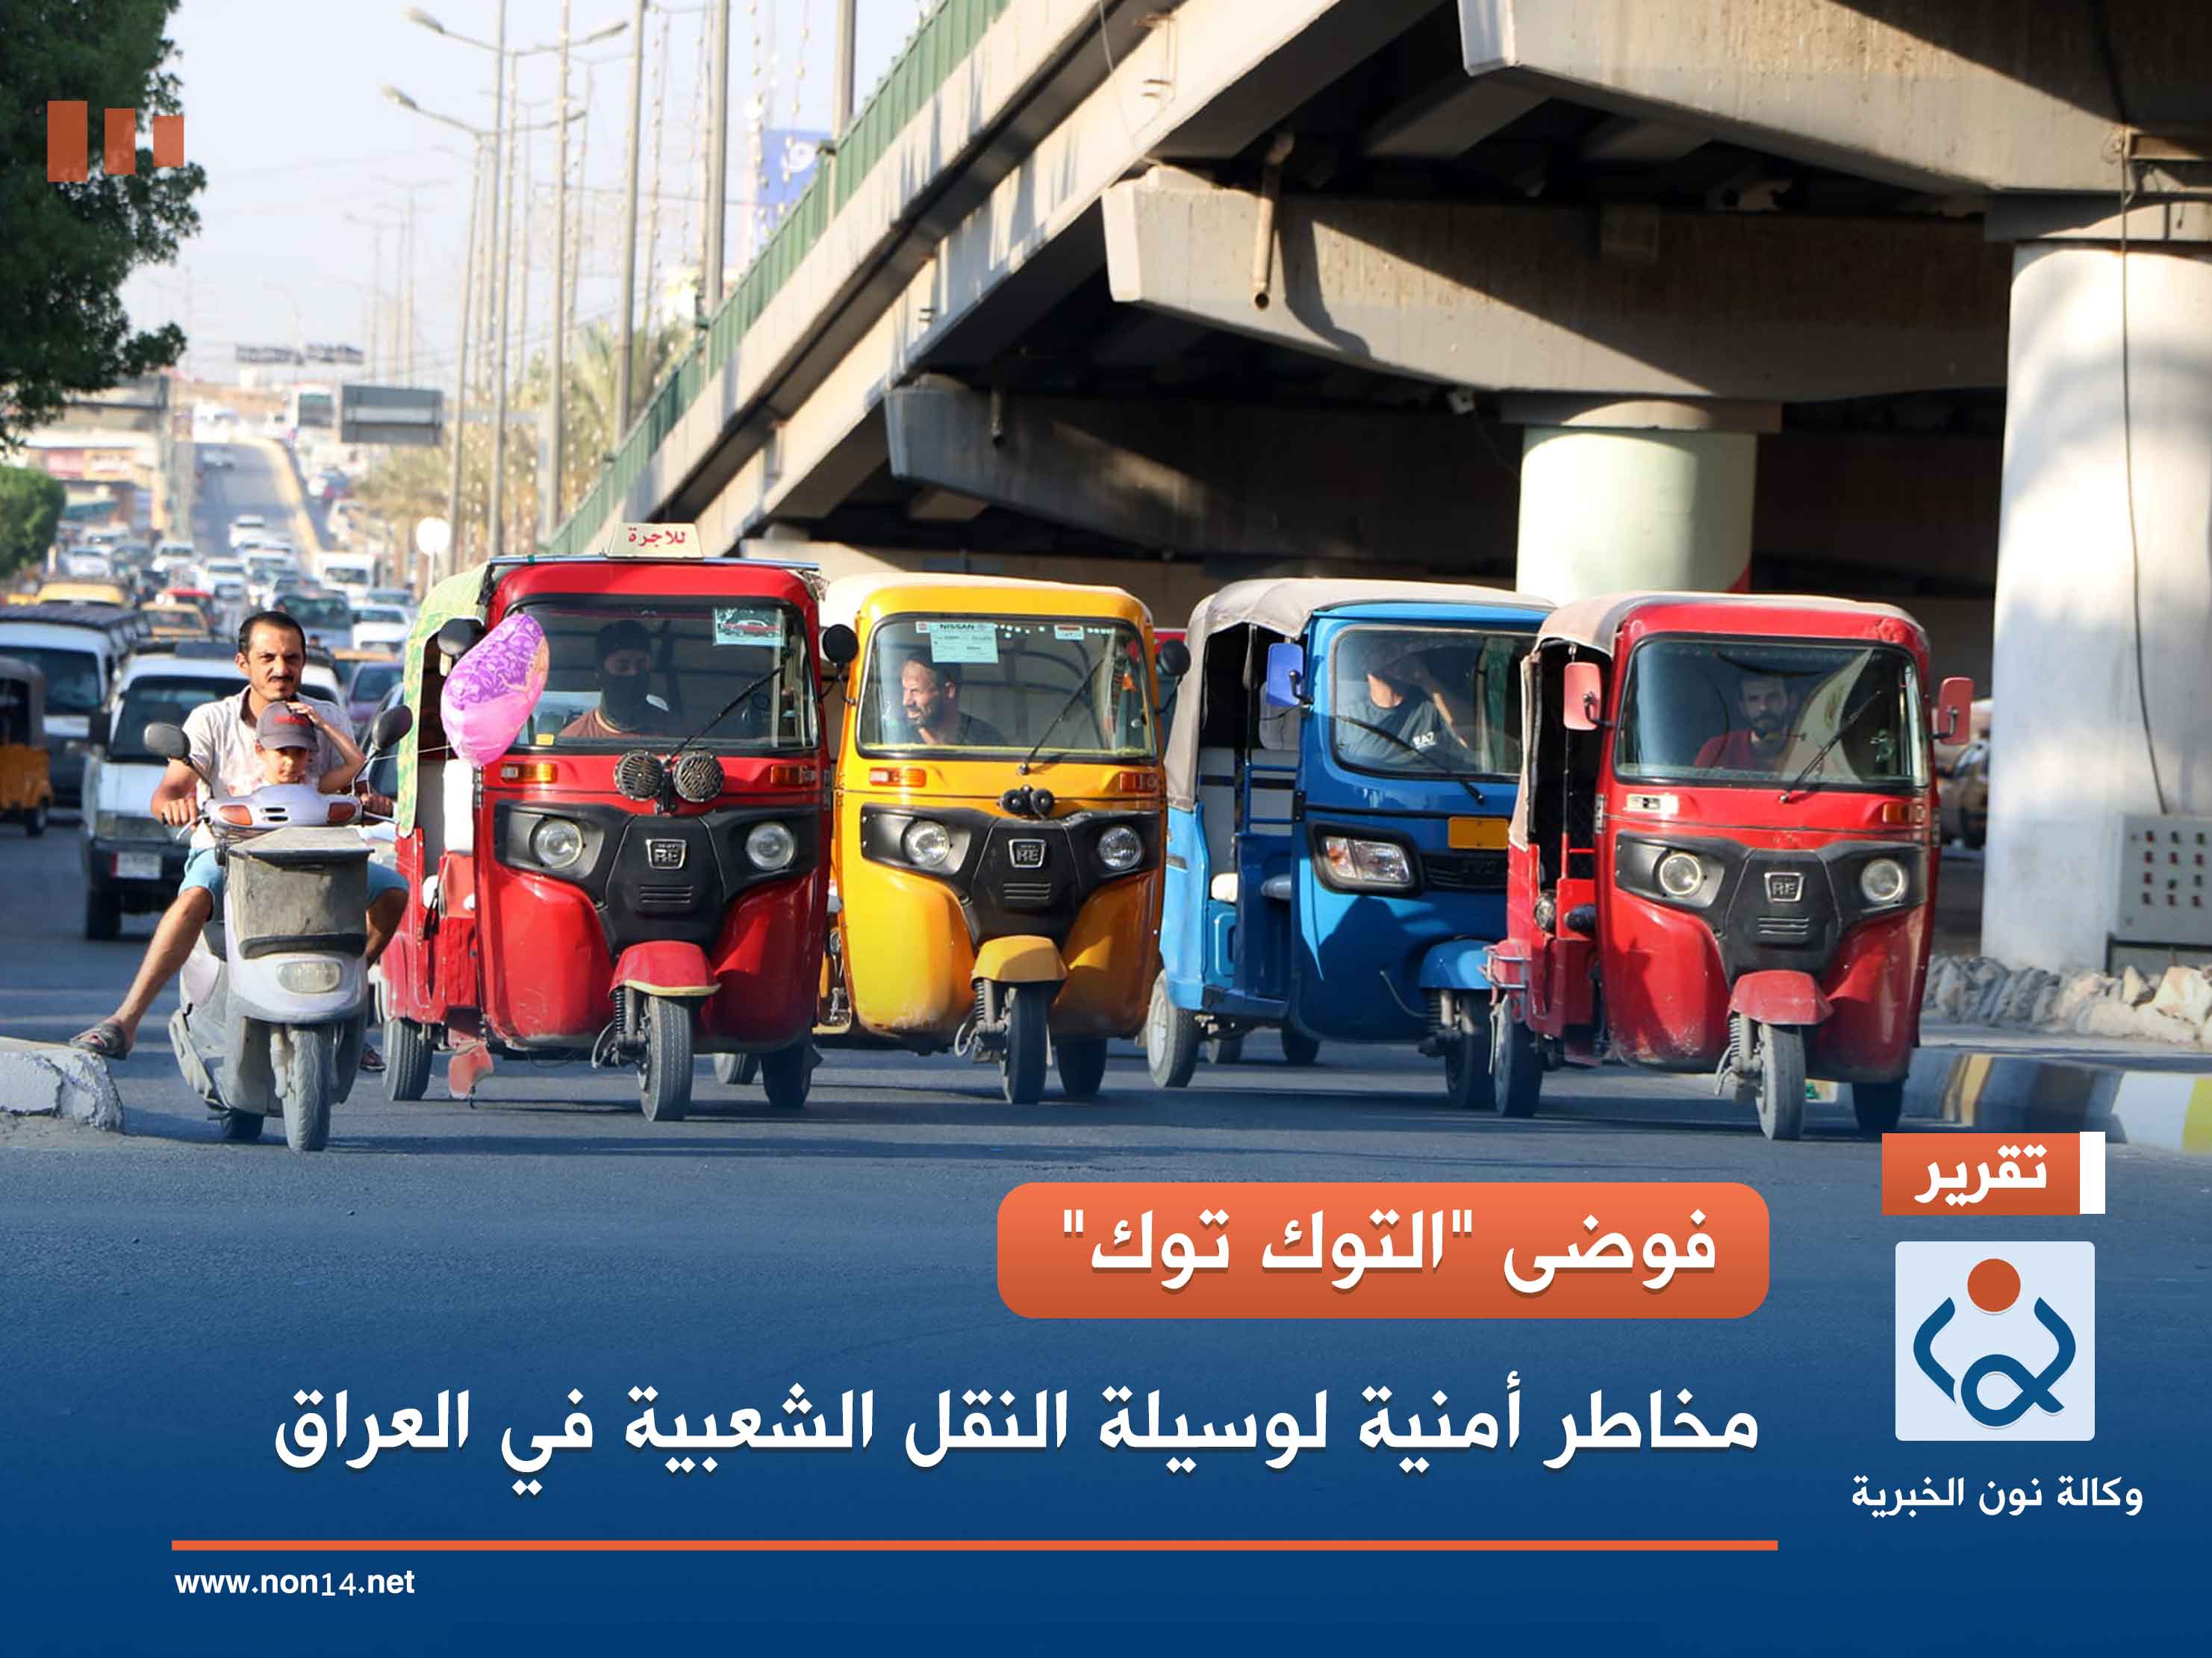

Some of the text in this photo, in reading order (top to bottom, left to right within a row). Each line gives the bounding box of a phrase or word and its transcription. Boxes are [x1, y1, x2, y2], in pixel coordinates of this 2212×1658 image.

[629, 527, 685, 547] للاجرة
[1016, 849, 1039, 861] RE
[1772, 882, 1796, 895] RE
